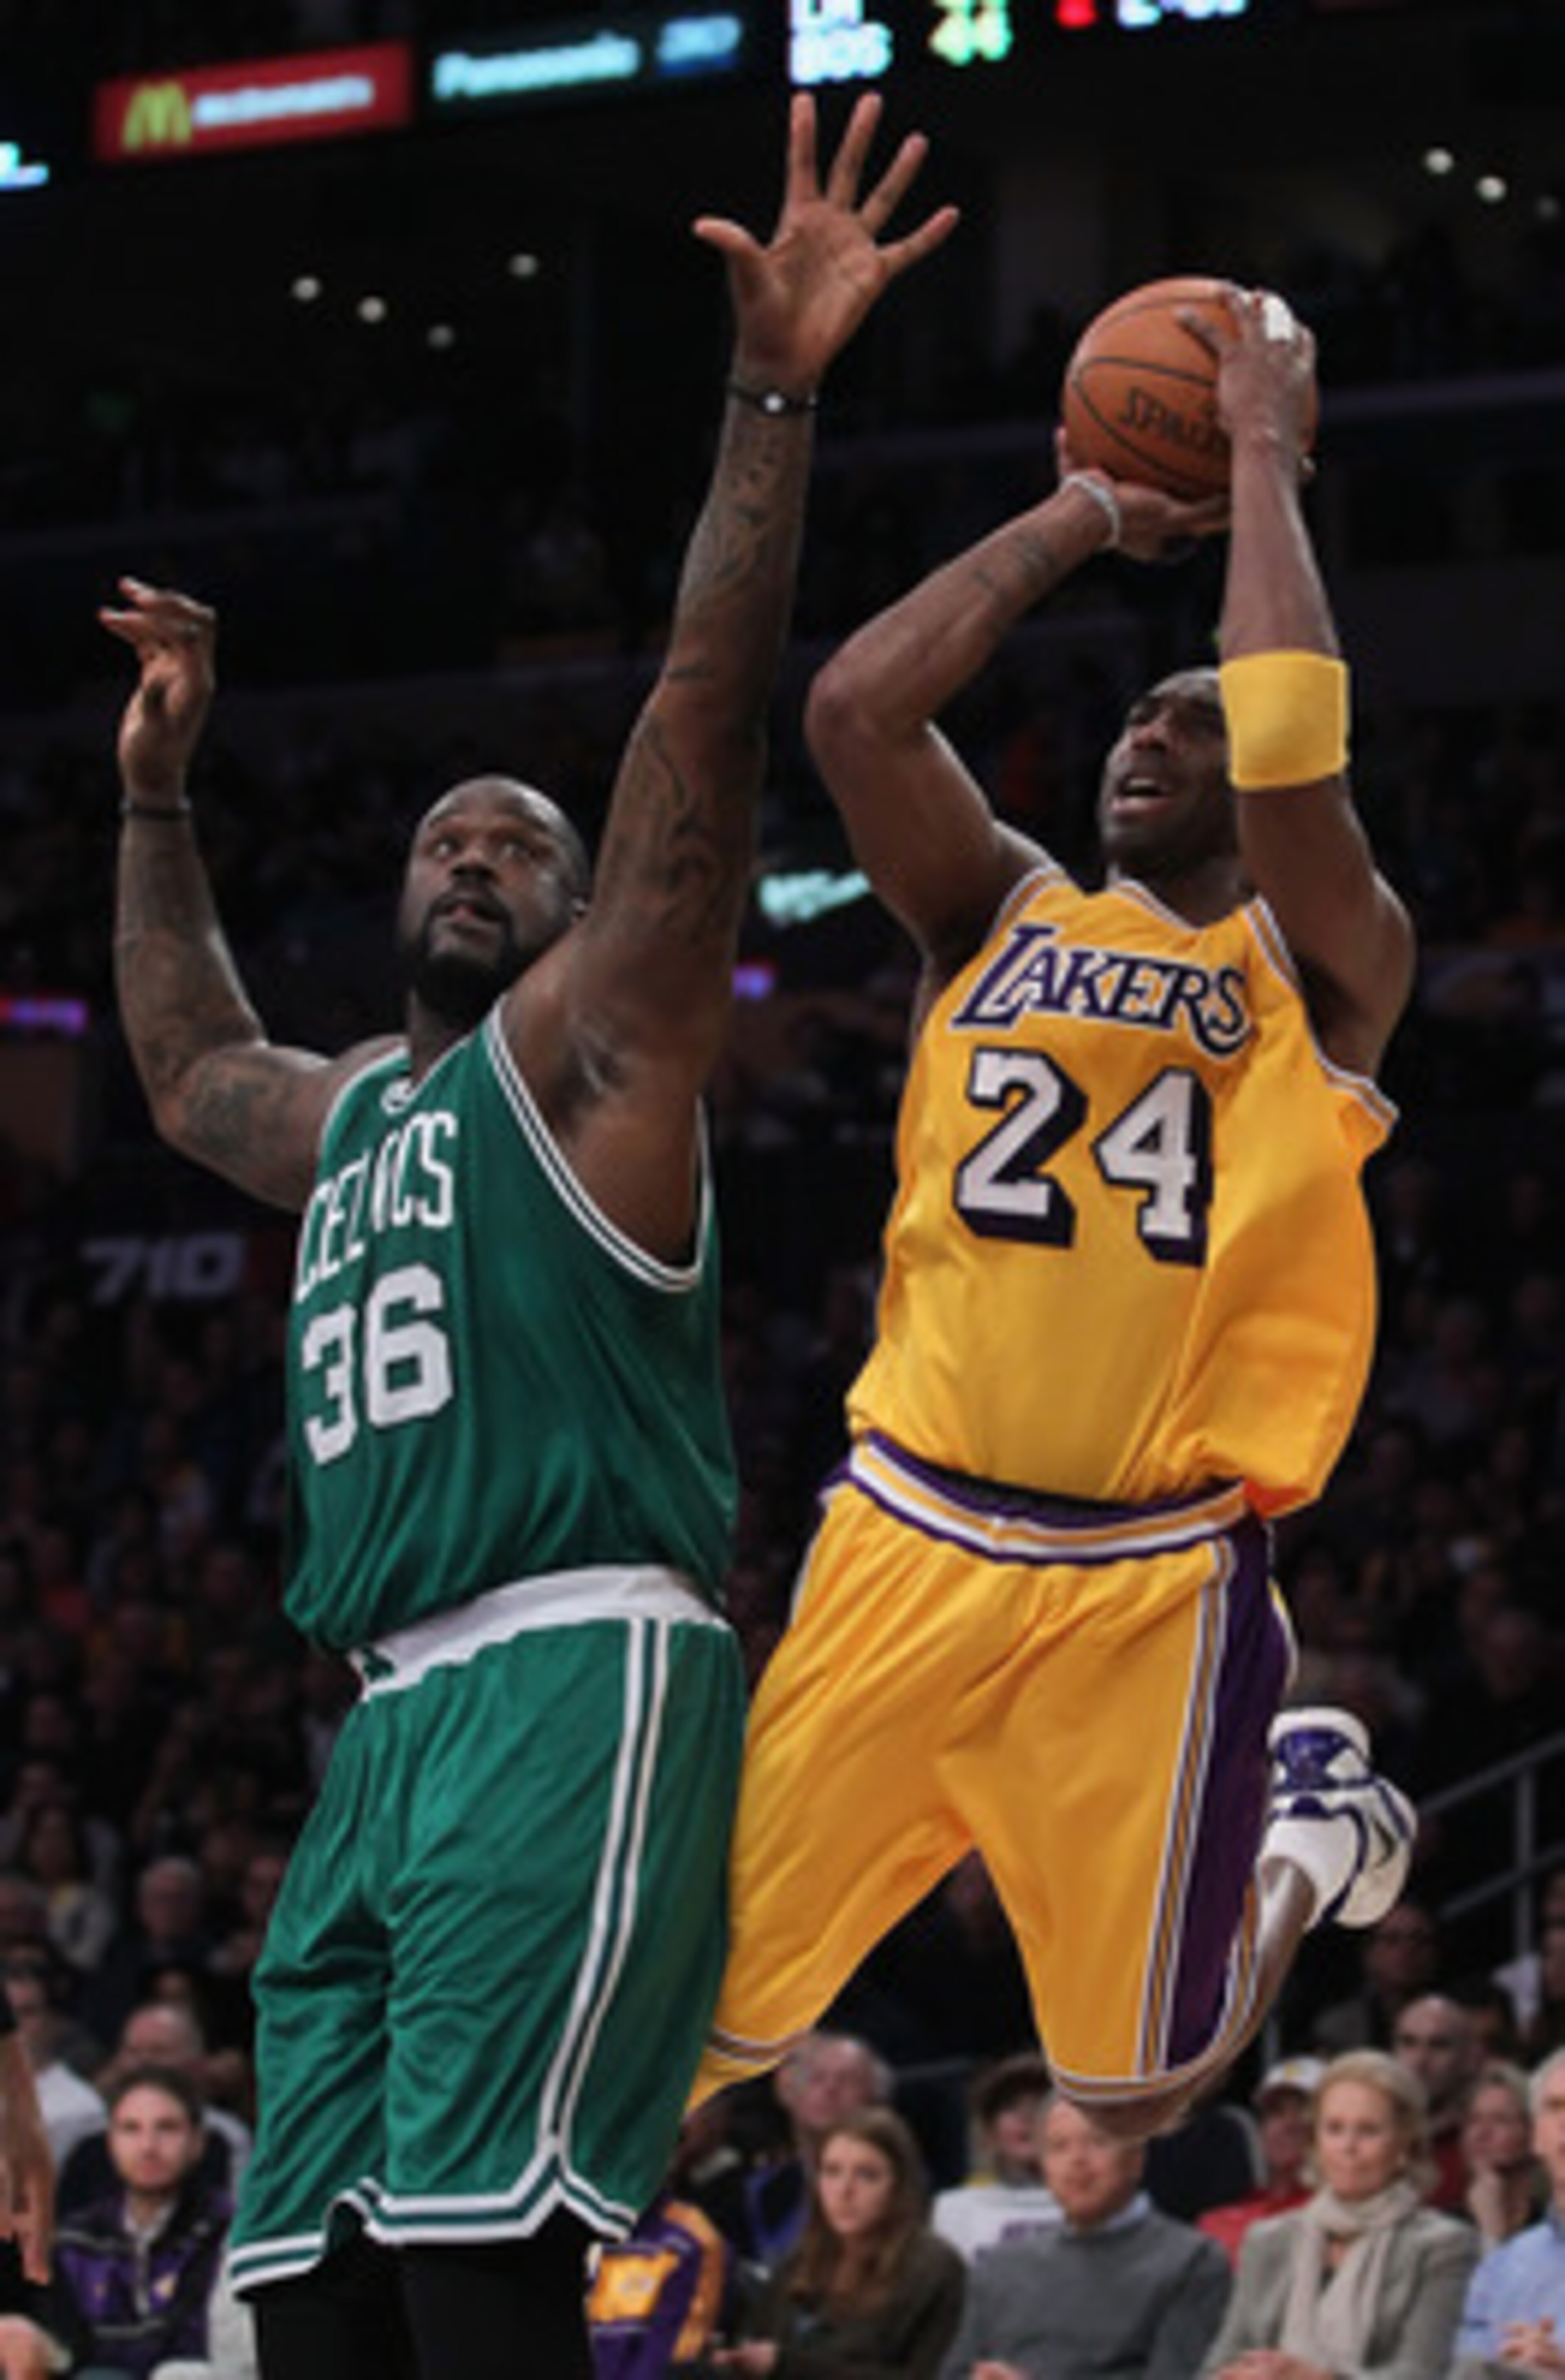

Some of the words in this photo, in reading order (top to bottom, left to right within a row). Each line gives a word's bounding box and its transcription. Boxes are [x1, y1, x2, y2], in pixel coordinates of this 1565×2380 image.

[948, 923, 1254, 1060] LAKERS
[952, 1044, 1215, 1267] 24
[82, 1234, 243, 1302] 710
[302, 1263, 453, 1464] 36
